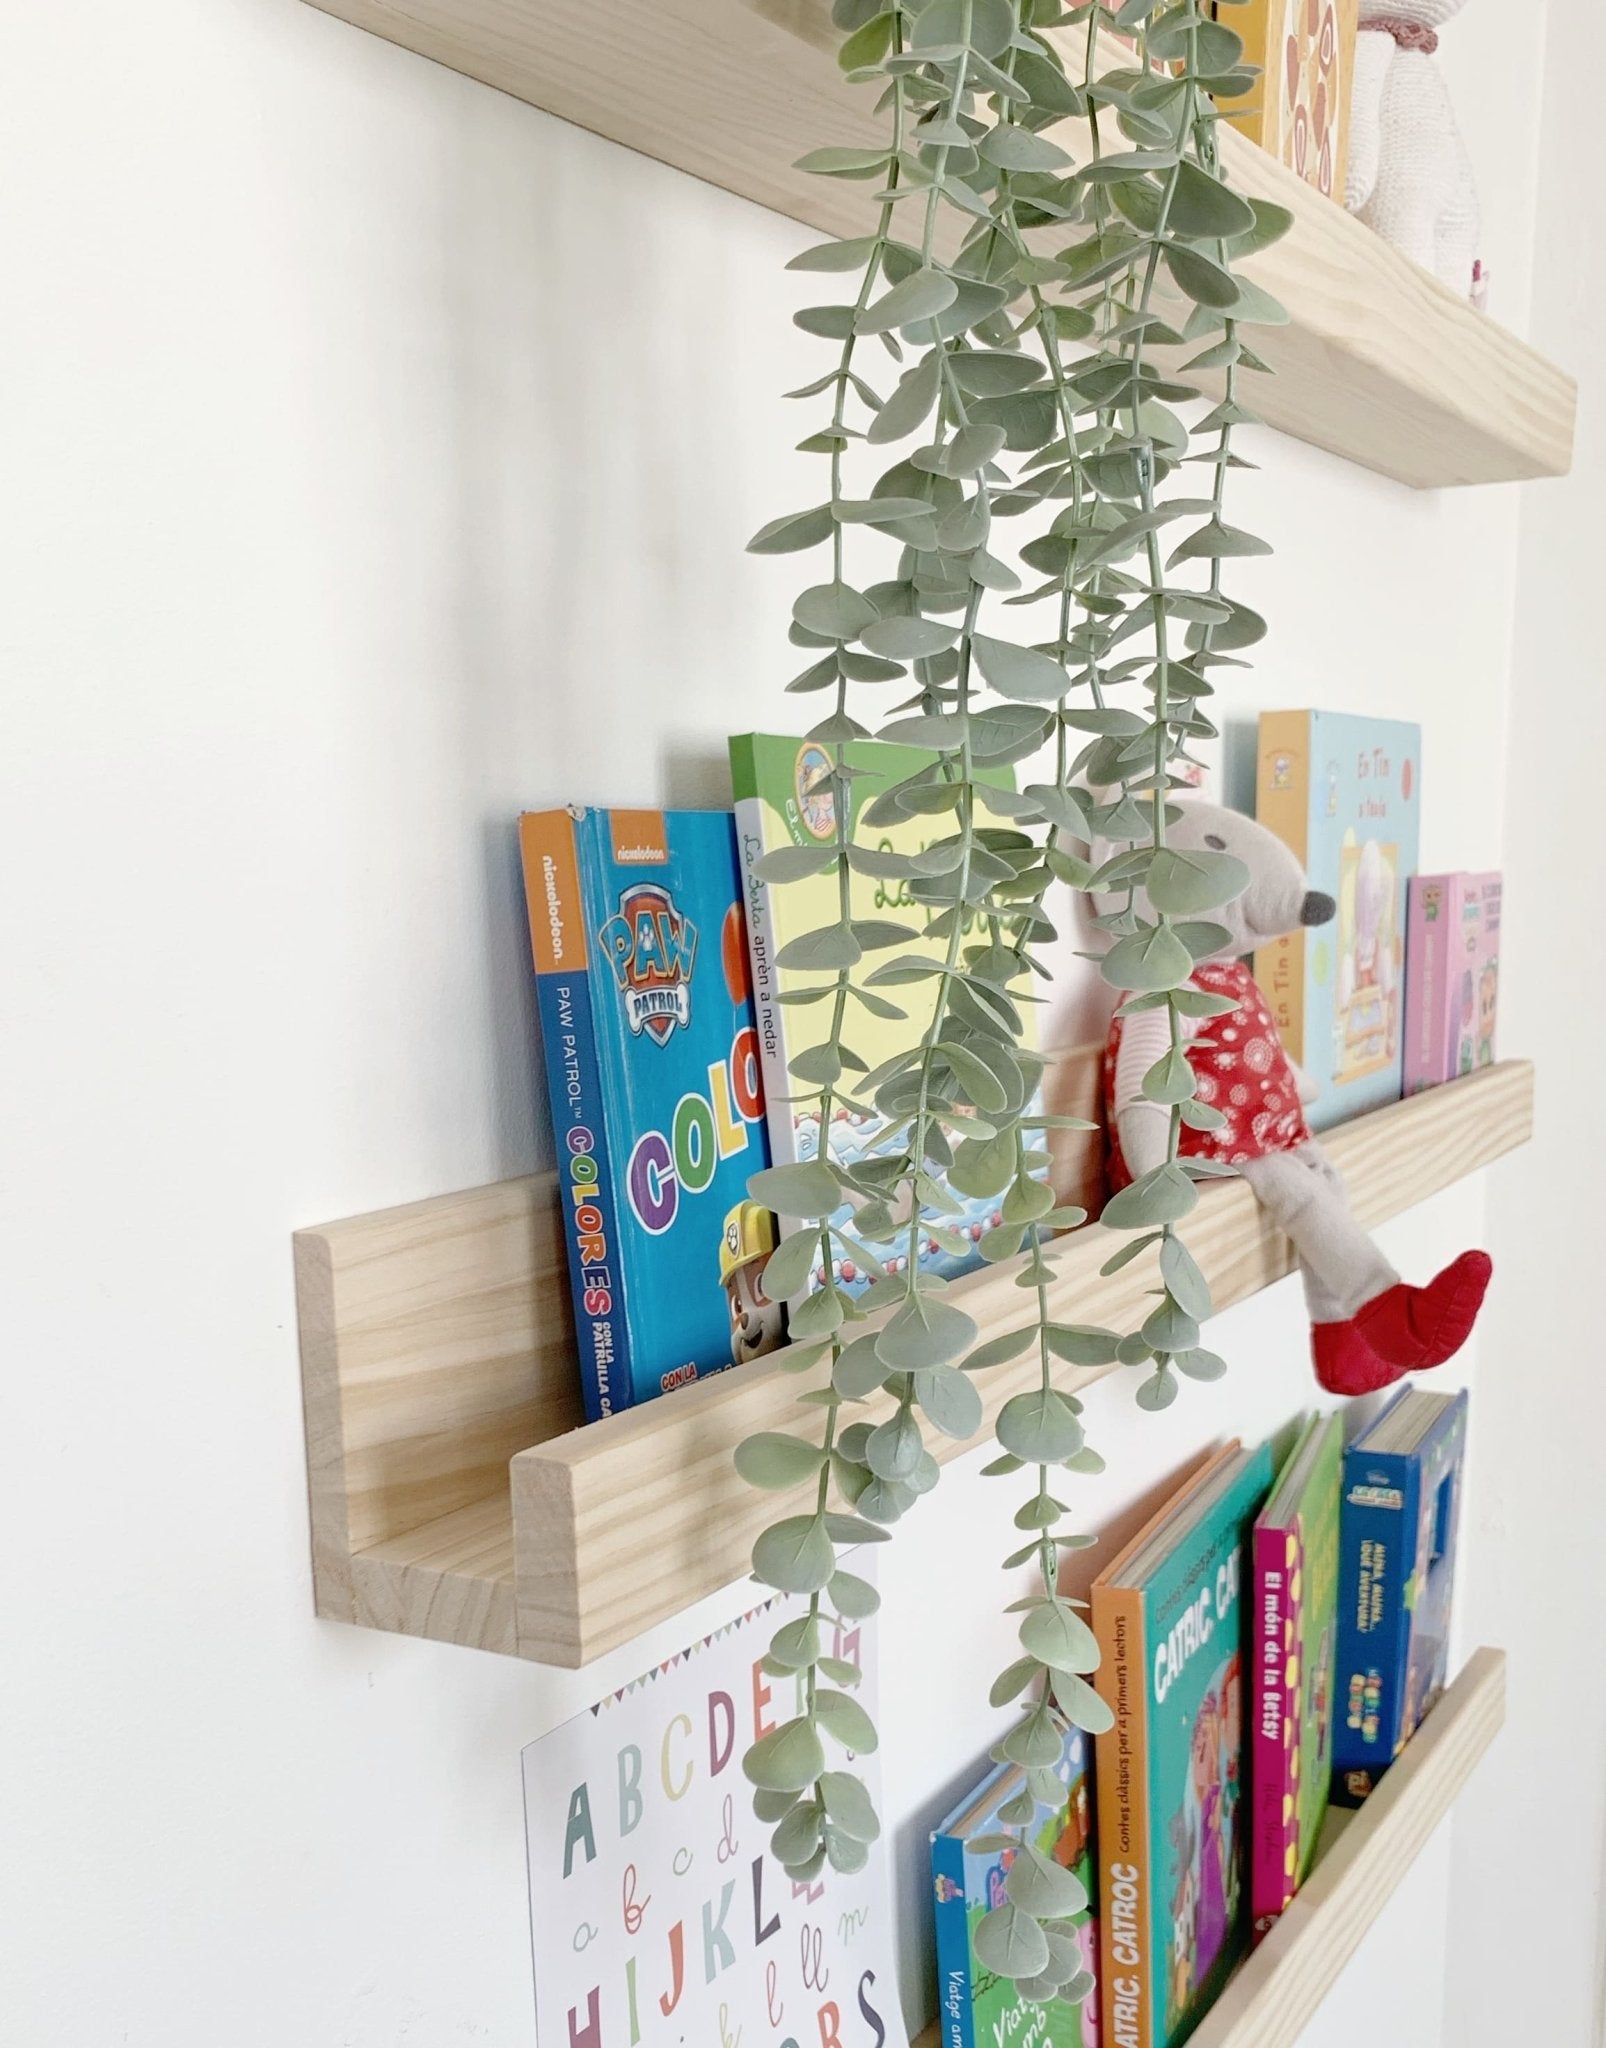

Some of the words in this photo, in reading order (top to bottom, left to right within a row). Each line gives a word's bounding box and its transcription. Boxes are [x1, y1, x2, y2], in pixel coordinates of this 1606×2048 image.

[616, 845, 665, 861] nickelodeon
[542, 855, 564, 959] nickelodeon
[599, 911, 699, 992] PAW
[753, 935, 771, 986] aprèn
[1272, 957, 1290, 993] Tin
[556, 987, 575, 1028] PAW
[633, 991, 683, 1019] PATROL
[760, 991, 771, 1002] a
[762, 1008, 778, 1058] nedar
[565, 1125, 612, 1317] COLORES
[602, 1321, 614, 1346] CON
[605, 1347, 615, 1364] LA
[592, 1322, 610, 1395] PATRULLA
[661, 1367, 683, 1392] CON
[683, 1360, 698, 1382] LA
[1264, 1571, 1283, 1589] El
[1113, 1615, 1128, 1662] lectors
[1263, 1594, 1284, 1636] món
[1263, 1640, 1283, 1665] de
[1115, 1664, 1132, 1716] primers
[1263, 1669, 1283, 1686] la
[1117, 1731, 1133, 1756] per
[1119, 1717, 1128, 1729] a
[562, 1781, 597, 1880] A
[617, 1743, 643, 1838] B
[660, 1713, 694, 1802] C
[708, 1690, 735, 1778] D
[752, 1654, 777, 1744] E
[1116, 1757, 1131, 1805] clàssics
[1118, 1806, 1131, 1854] Contes
[572, 1921, 599, 1952] a
[622, 1863, 652, 1935] b
[672, 1846, 694, 1877] c
[717, 1793, 739, 1864] d
[838, 1905, 869, 1947] m
[1110, 1863, 1141, 1967] CATROC
[625, 1956, 641, 2047] I
[658, 1920, 684, 2018] J
[702, 1878, 737, 1986] K
[751, 1854, 782, 1947] L
[858, 1969, 885, 2048] S
[944, 1970, 966, 2019] Viatge
